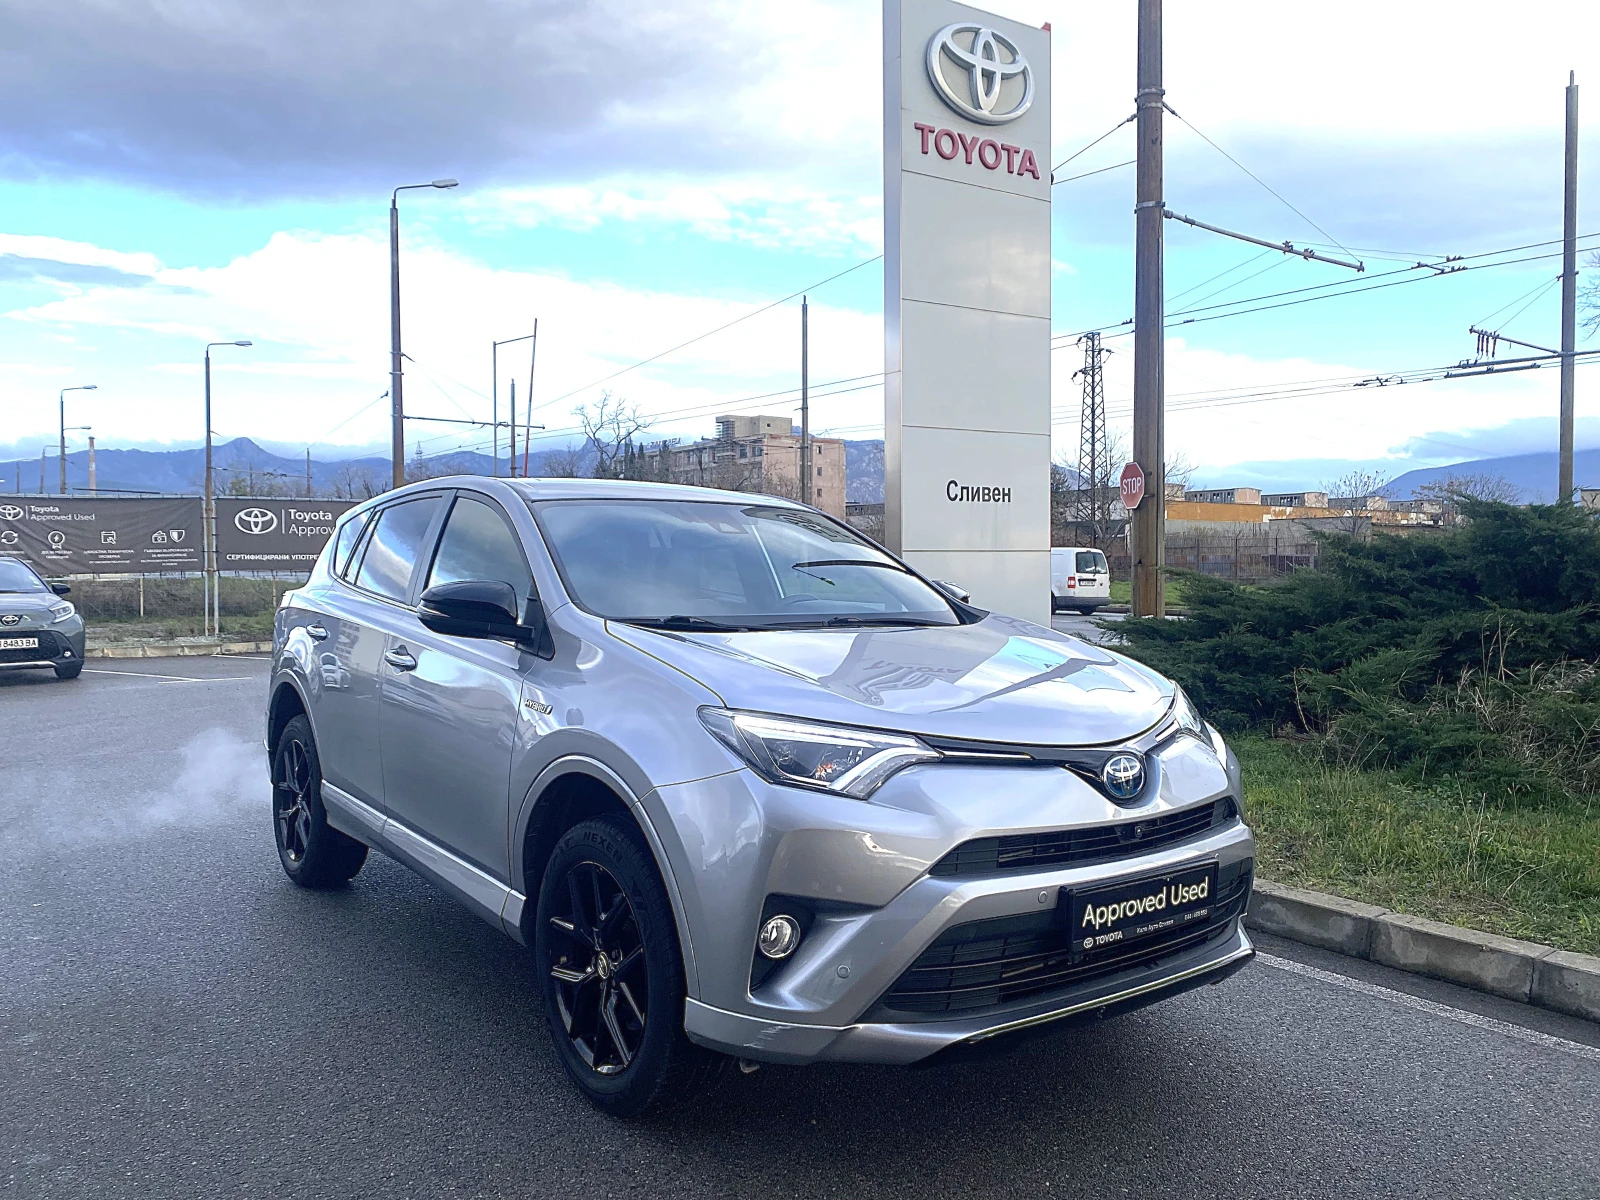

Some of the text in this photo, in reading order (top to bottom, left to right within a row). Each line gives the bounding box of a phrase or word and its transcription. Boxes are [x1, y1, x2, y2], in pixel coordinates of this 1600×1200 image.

[914, 122, 1040, 180] TOYOTA
[946, 479, 1011, 503] Сливен
[1122, 479, 1142, 495] STOP
[30, 505, 59, 514] Toyota
[30, 513, 95, 521] Approved Used
[288, 508, 332, 522] Toyota
[226, 553, 290, 561] СЕРТИФИЦИРАНИ
[3, 639, 23, 648] 8483
[582, 831, 623, 864] NEXEN
[1082, 876, 1209, 930] Approved Used
[1095, 930, 1123, 946] TOYOTA
